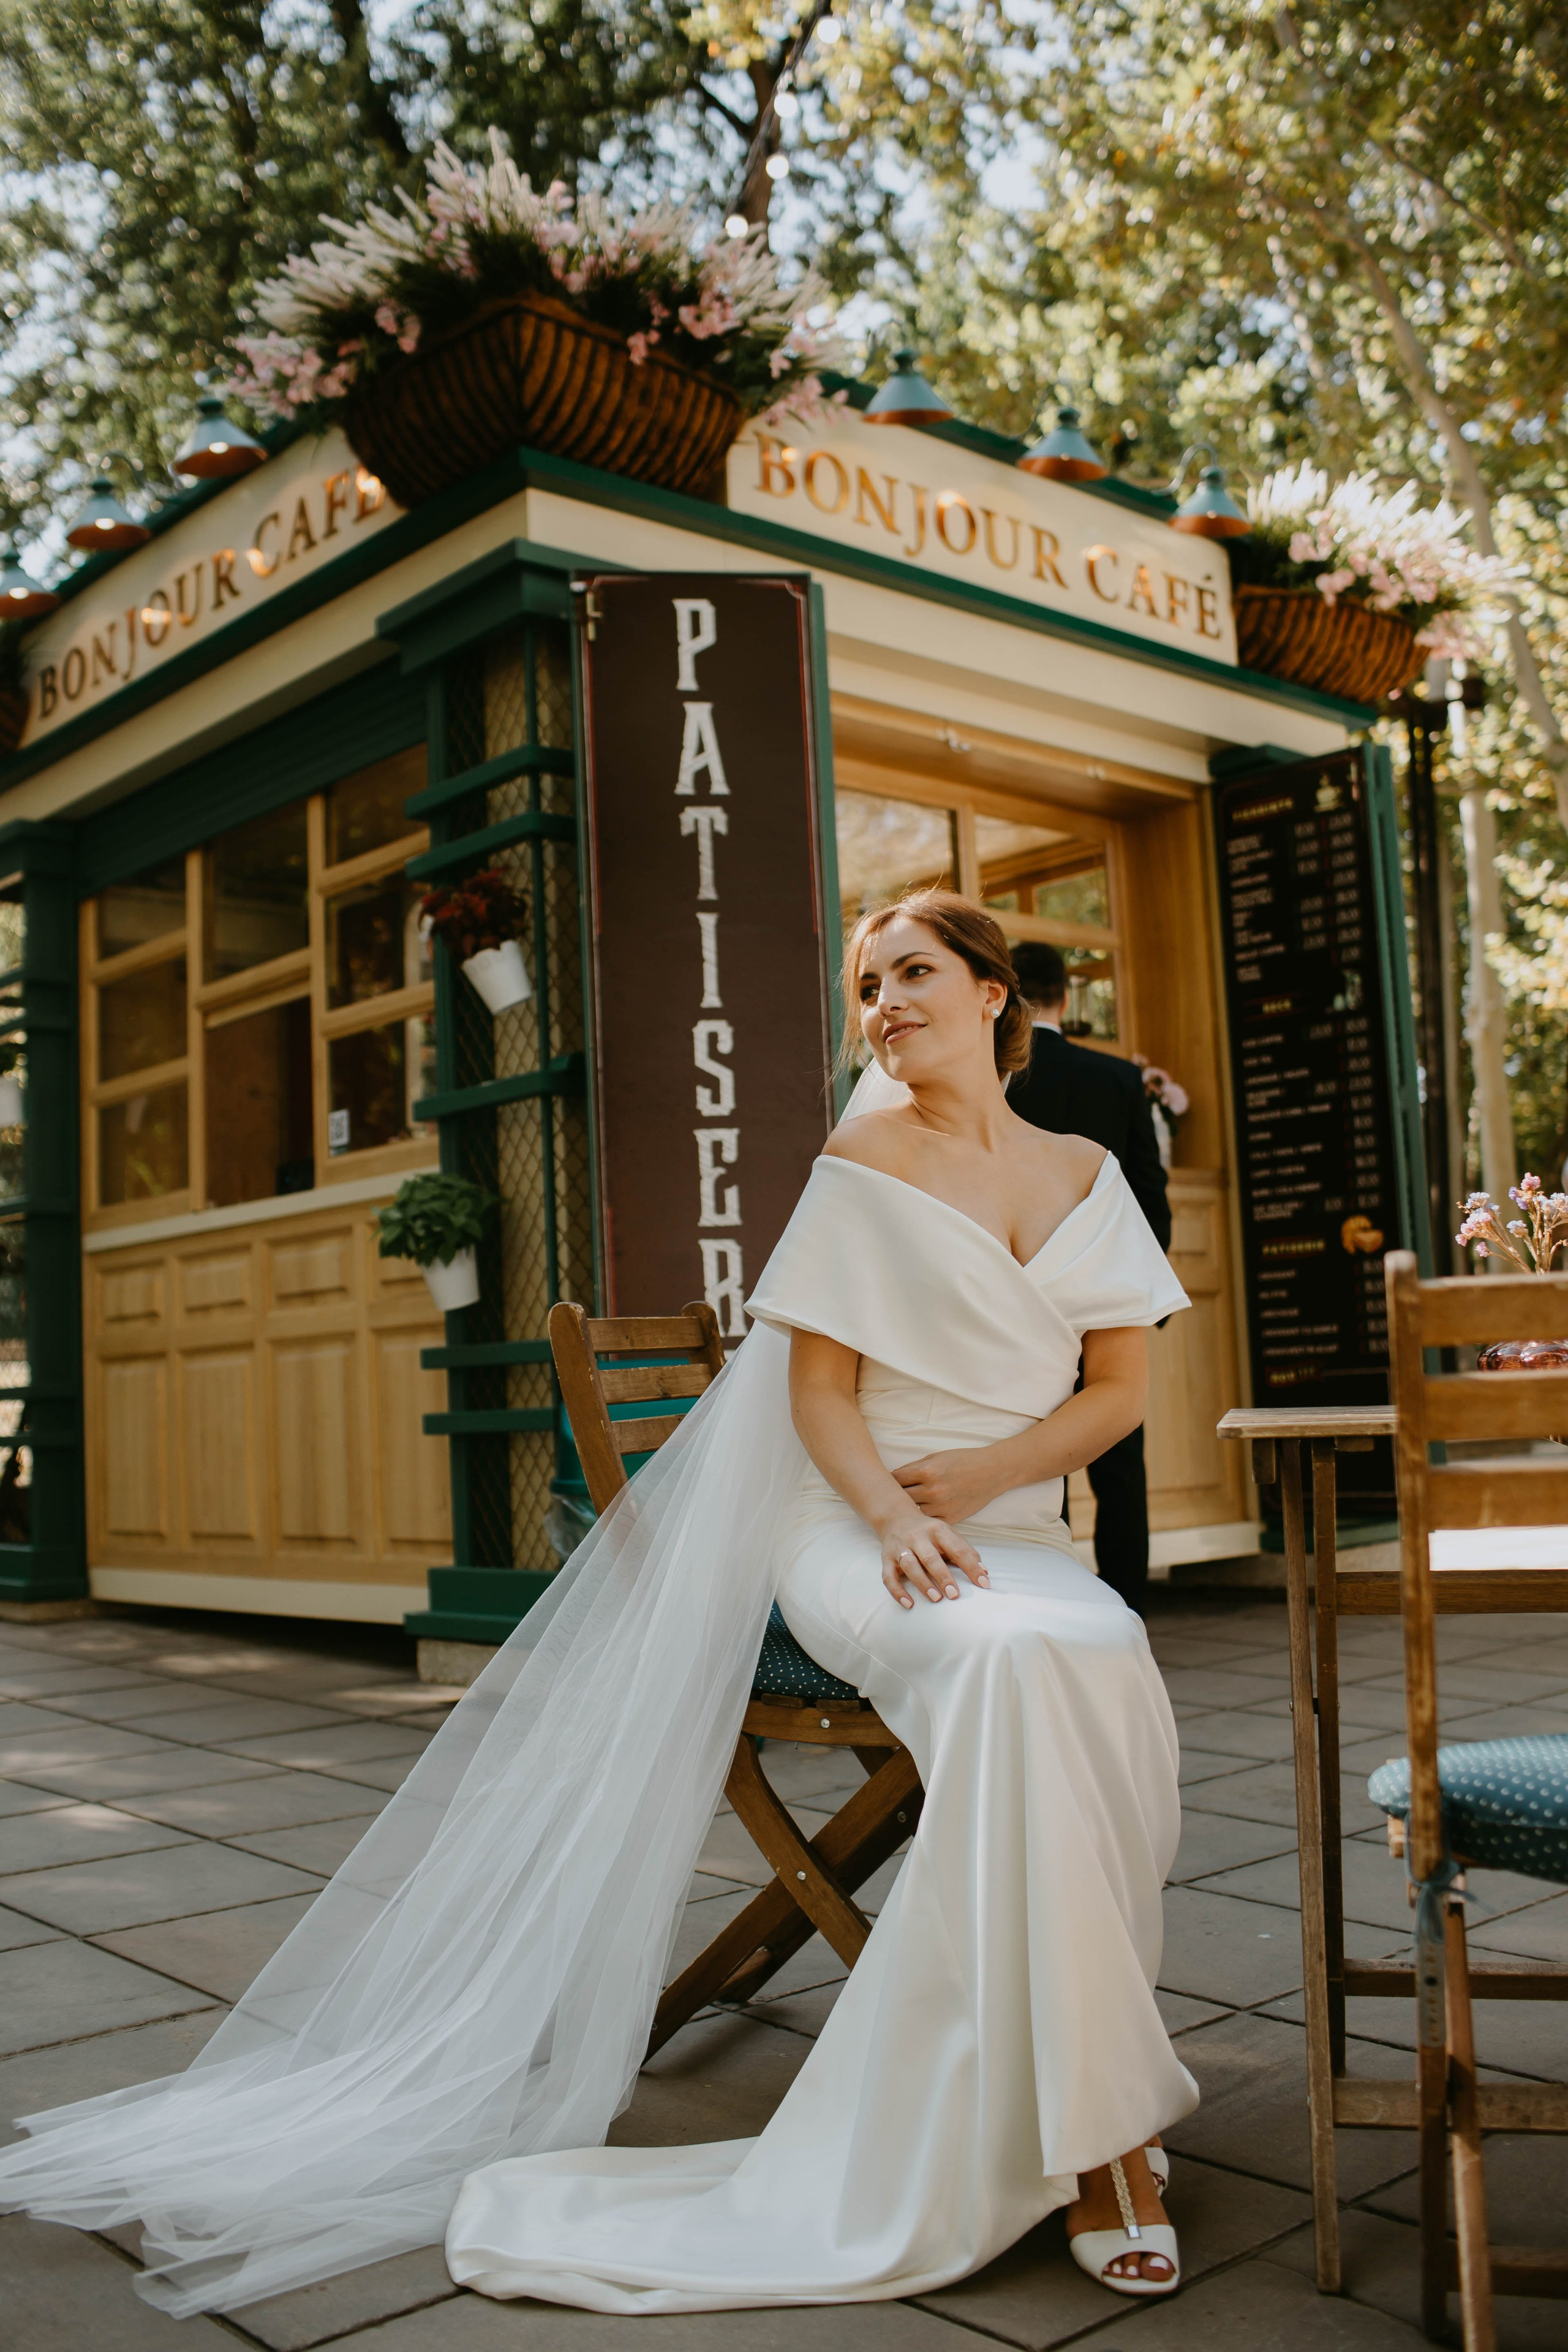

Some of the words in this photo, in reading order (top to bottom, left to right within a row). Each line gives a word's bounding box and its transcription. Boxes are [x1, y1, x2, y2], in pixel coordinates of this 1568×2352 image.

[39, 548, 241, 720] BONJOUR
[754, 431, 1070, 590] BONJOUR
[1085, 545, 1223, 641] CAFÉ
[671, 598, 748, 1361] PATISER
